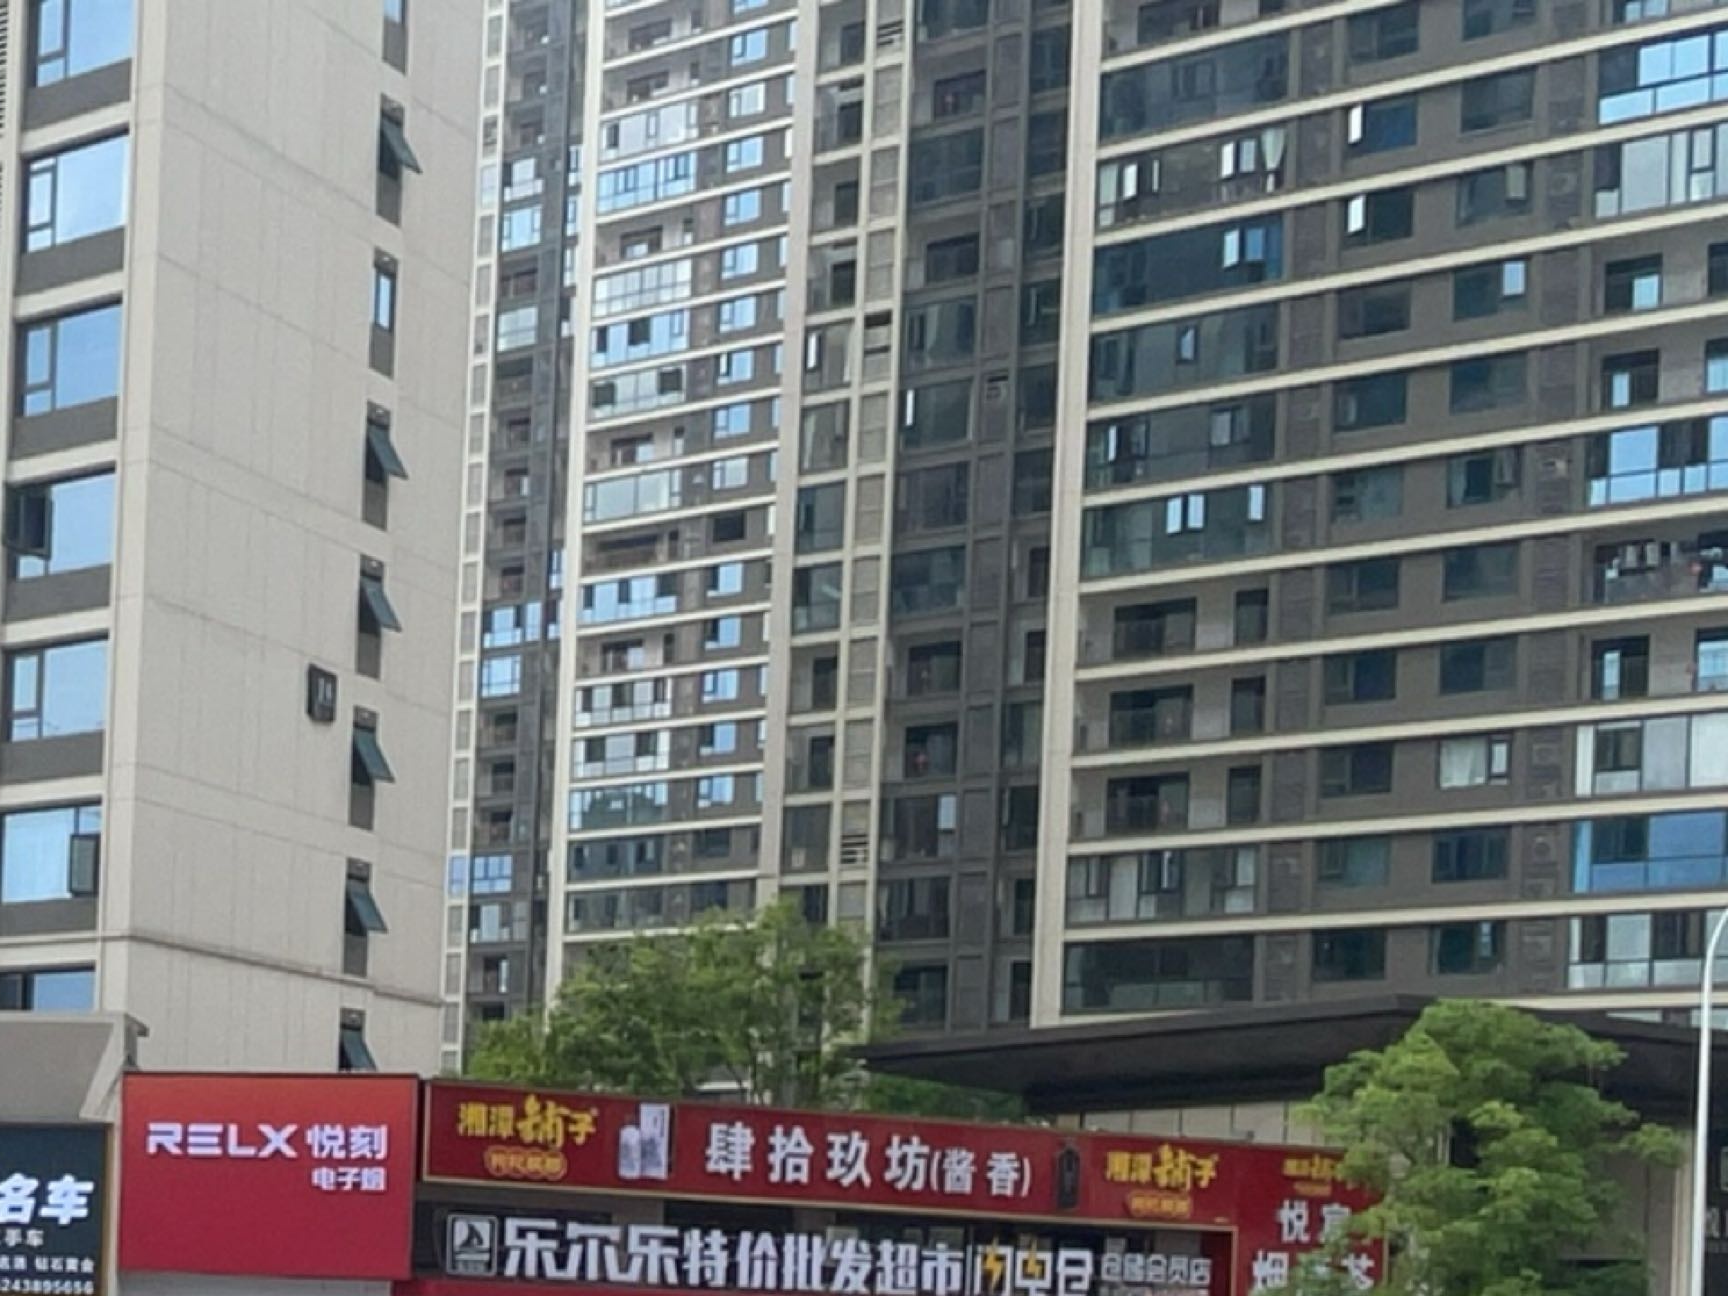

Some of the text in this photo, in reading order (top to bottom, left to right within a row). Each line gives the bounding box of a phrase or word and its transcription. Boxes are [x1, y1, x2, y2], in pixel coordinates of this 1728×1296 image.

[146, 1122, 389, 1160] RELX 悦刻
[311, 1165, 388, 1192] 电子烟
